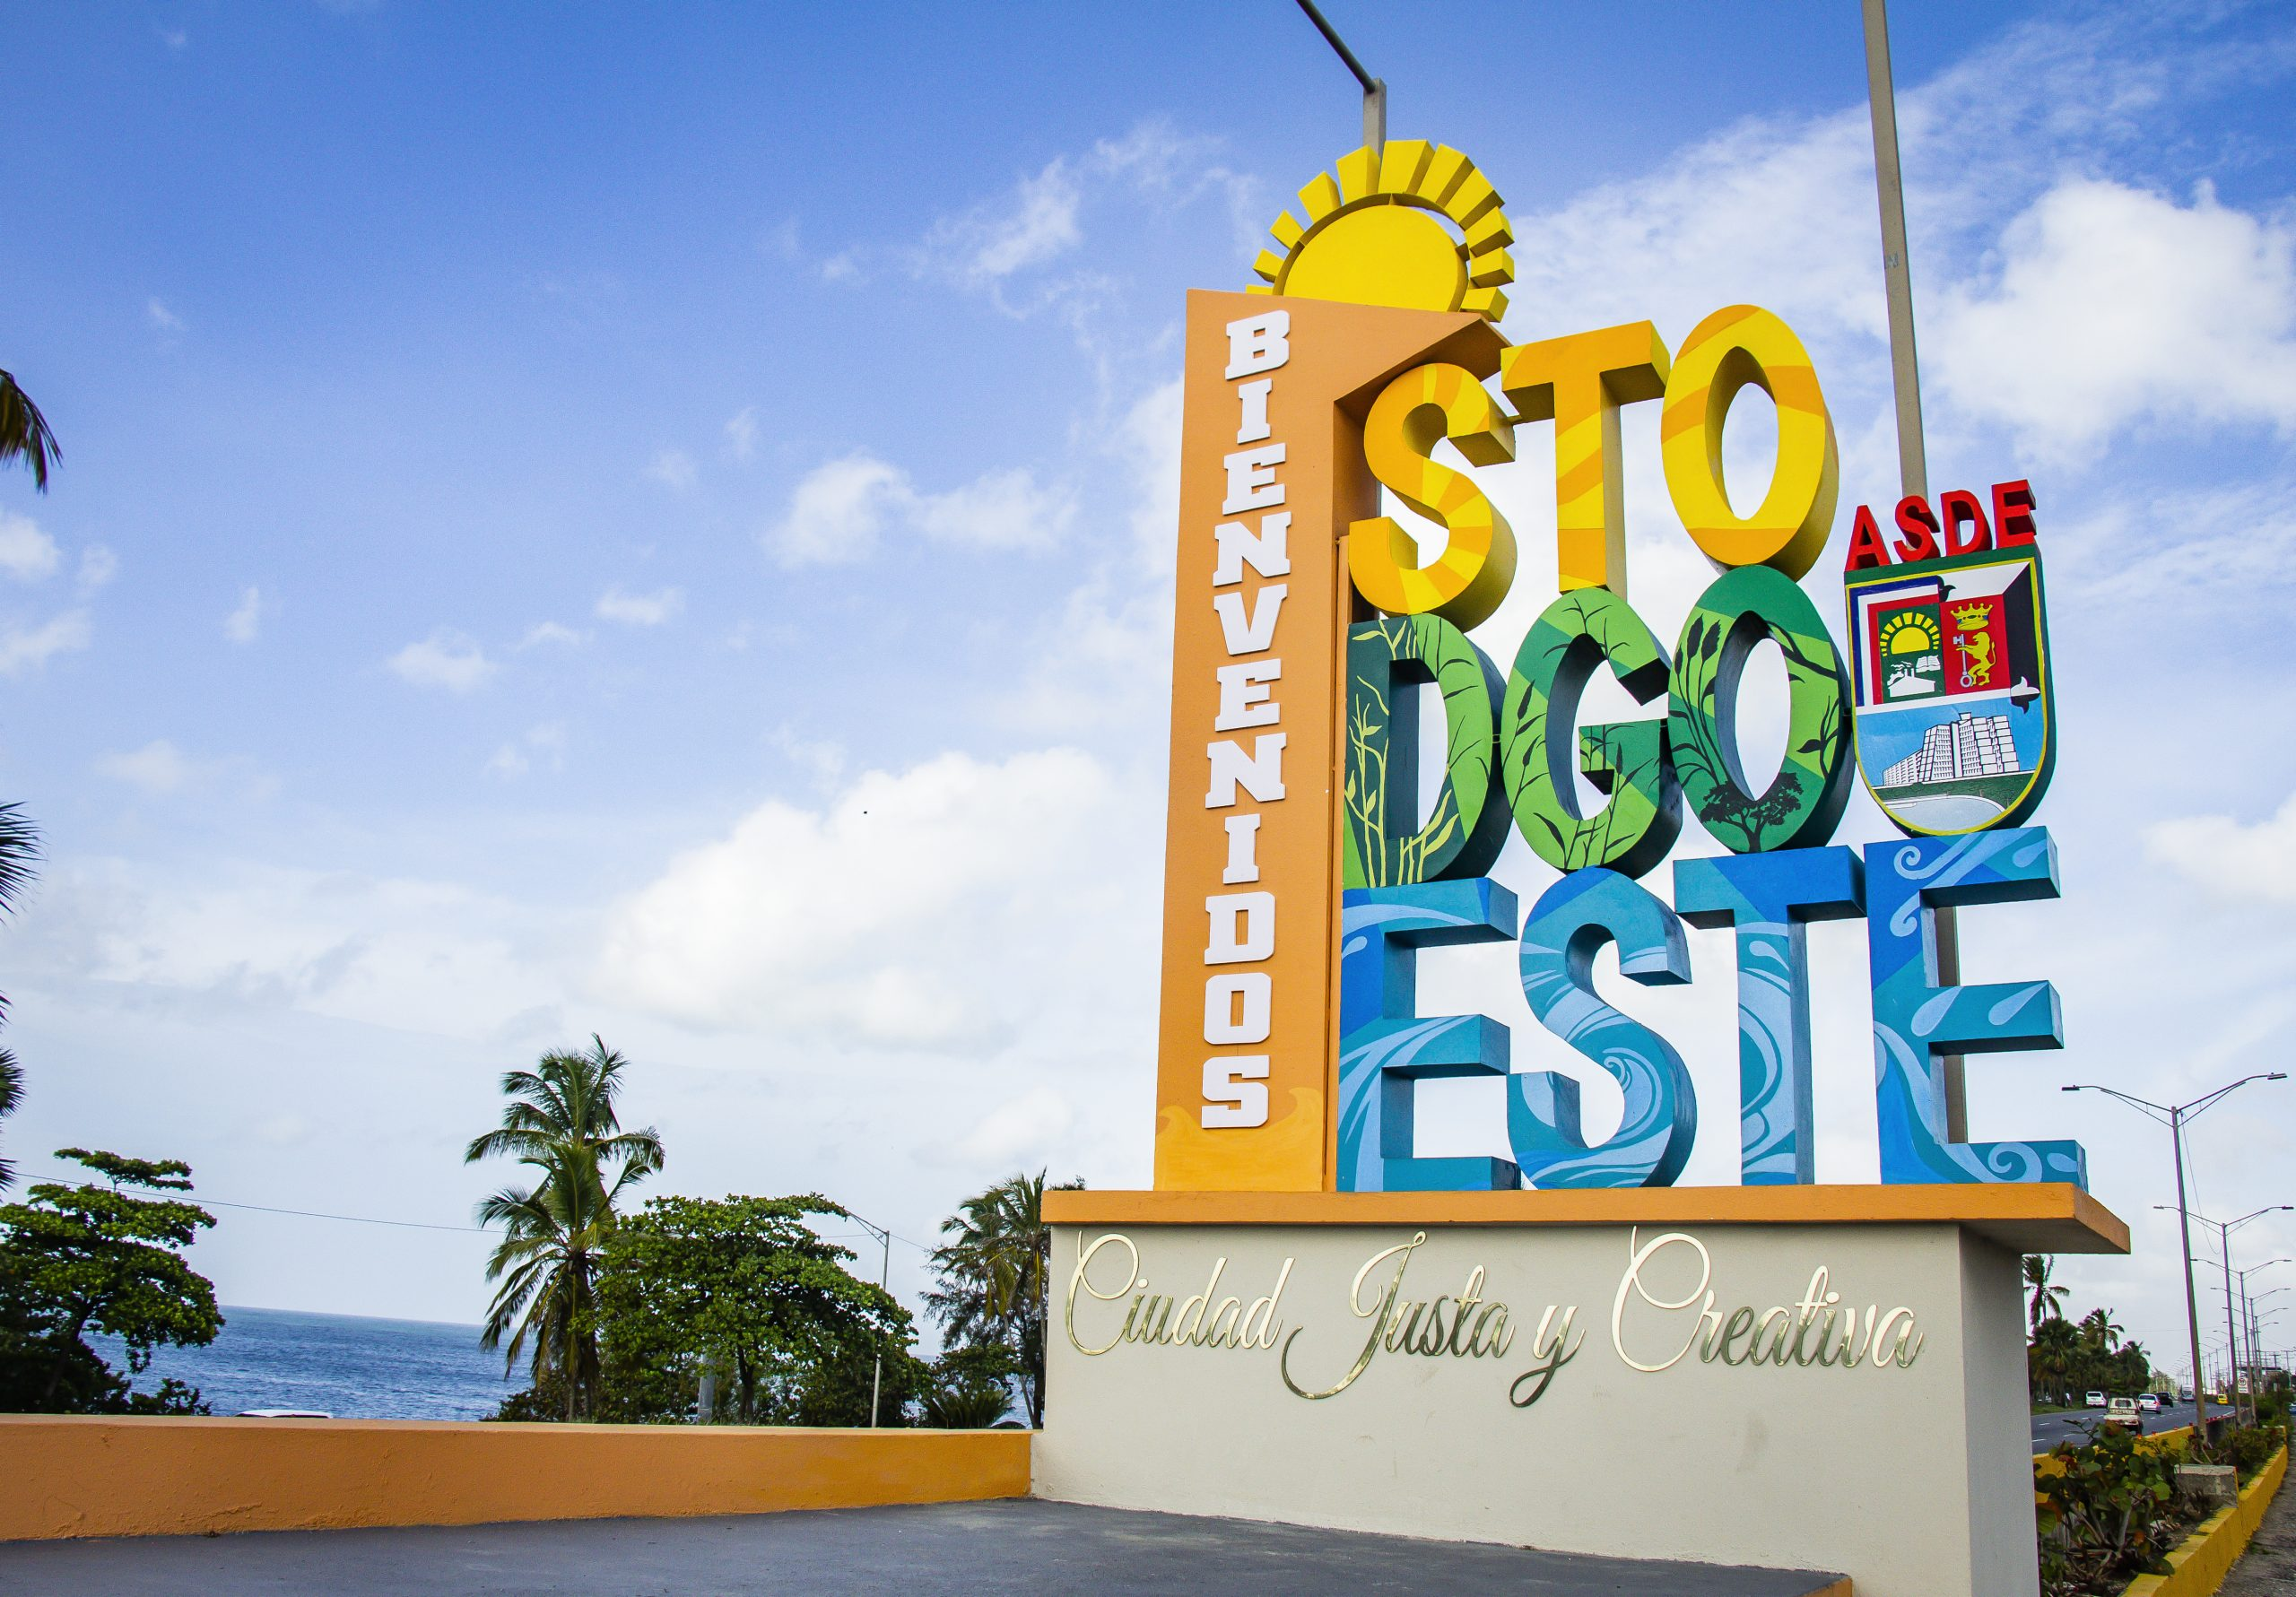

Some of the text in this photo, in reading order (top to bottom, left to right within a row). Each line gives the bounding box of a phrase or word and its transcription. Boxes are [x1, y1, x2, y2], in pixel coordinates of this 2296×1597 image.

[1348, 304, 1839, 632] STO
[1845, 479, 2036, 572] ASDE
[1202, 309, 1292, 1129] BIENVENIDOS
[1344, 564, 1856, 888] DGO
[1337, 825, 2089, 1191] ESTE
[1065, 1224, 1926, 1409] Ciudad Justa y Creativa
